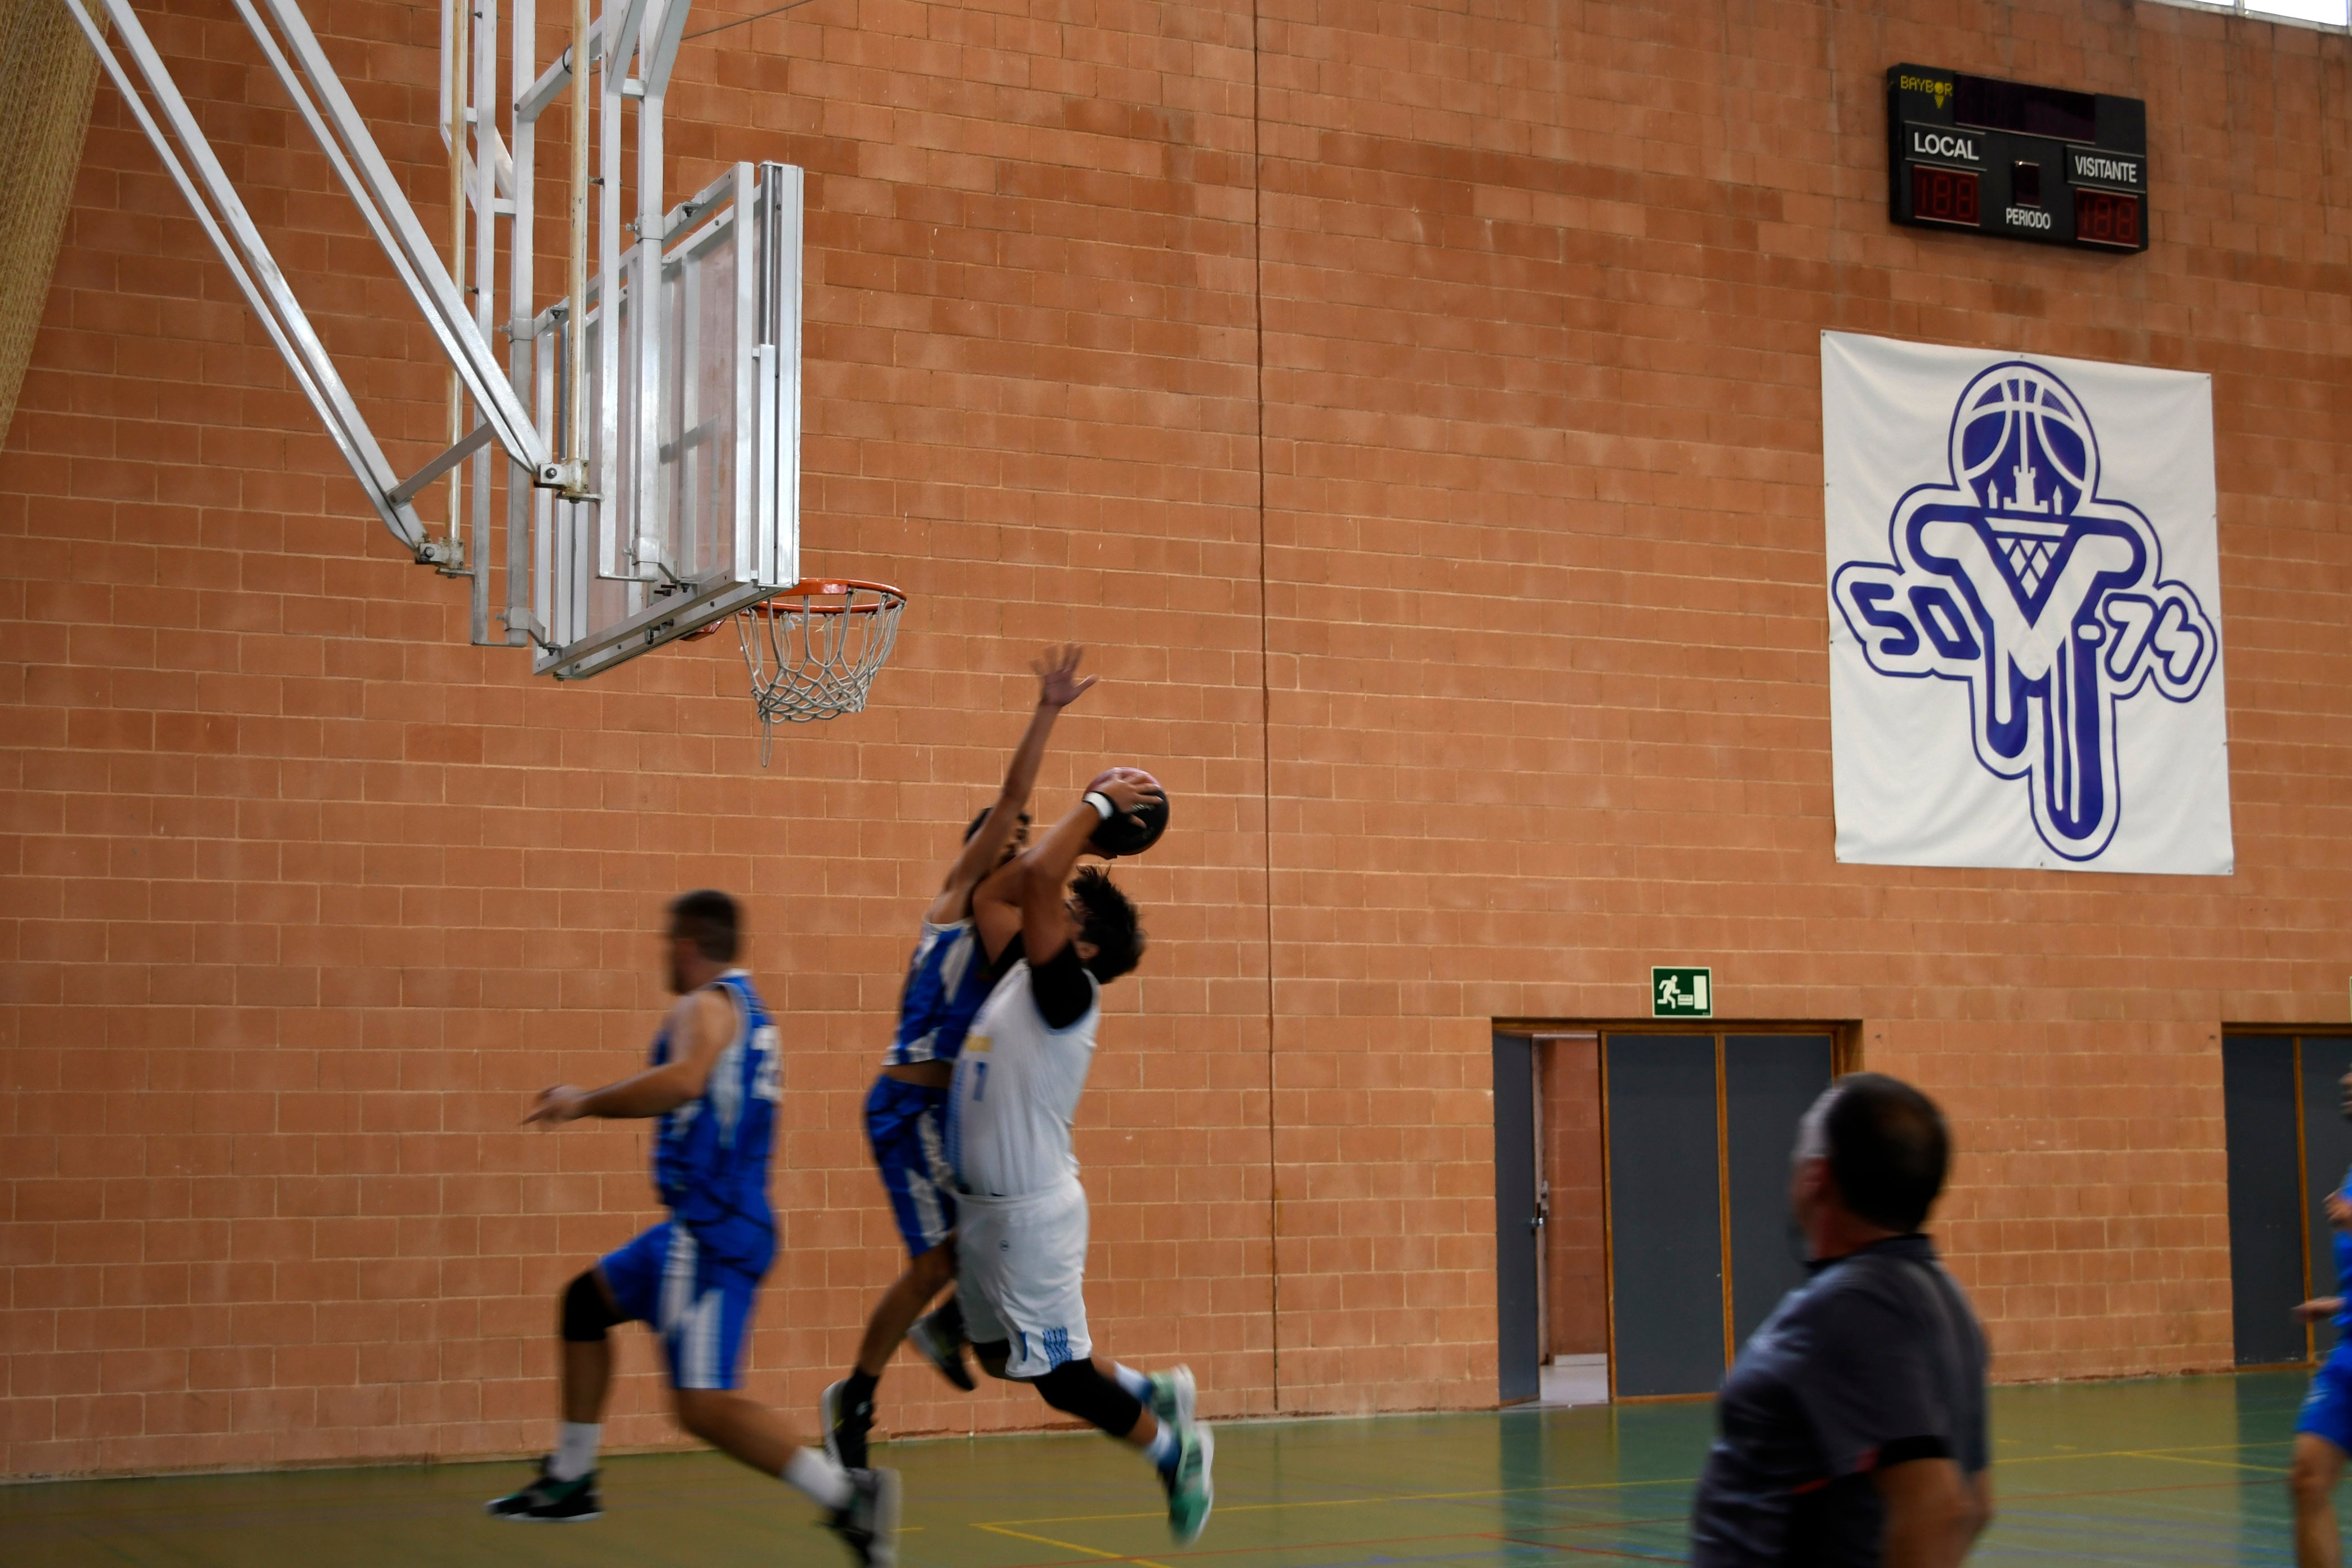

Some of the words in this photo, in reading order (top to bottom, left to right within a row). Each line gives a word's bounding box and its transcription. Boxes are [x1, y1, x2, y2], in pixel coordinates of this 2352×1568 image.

[1914, 131, 1980, 161] LOCAL
[2074, 155, 2137, 184] VISITANTE
[2005, 207, 2051, 230] PERIODO
